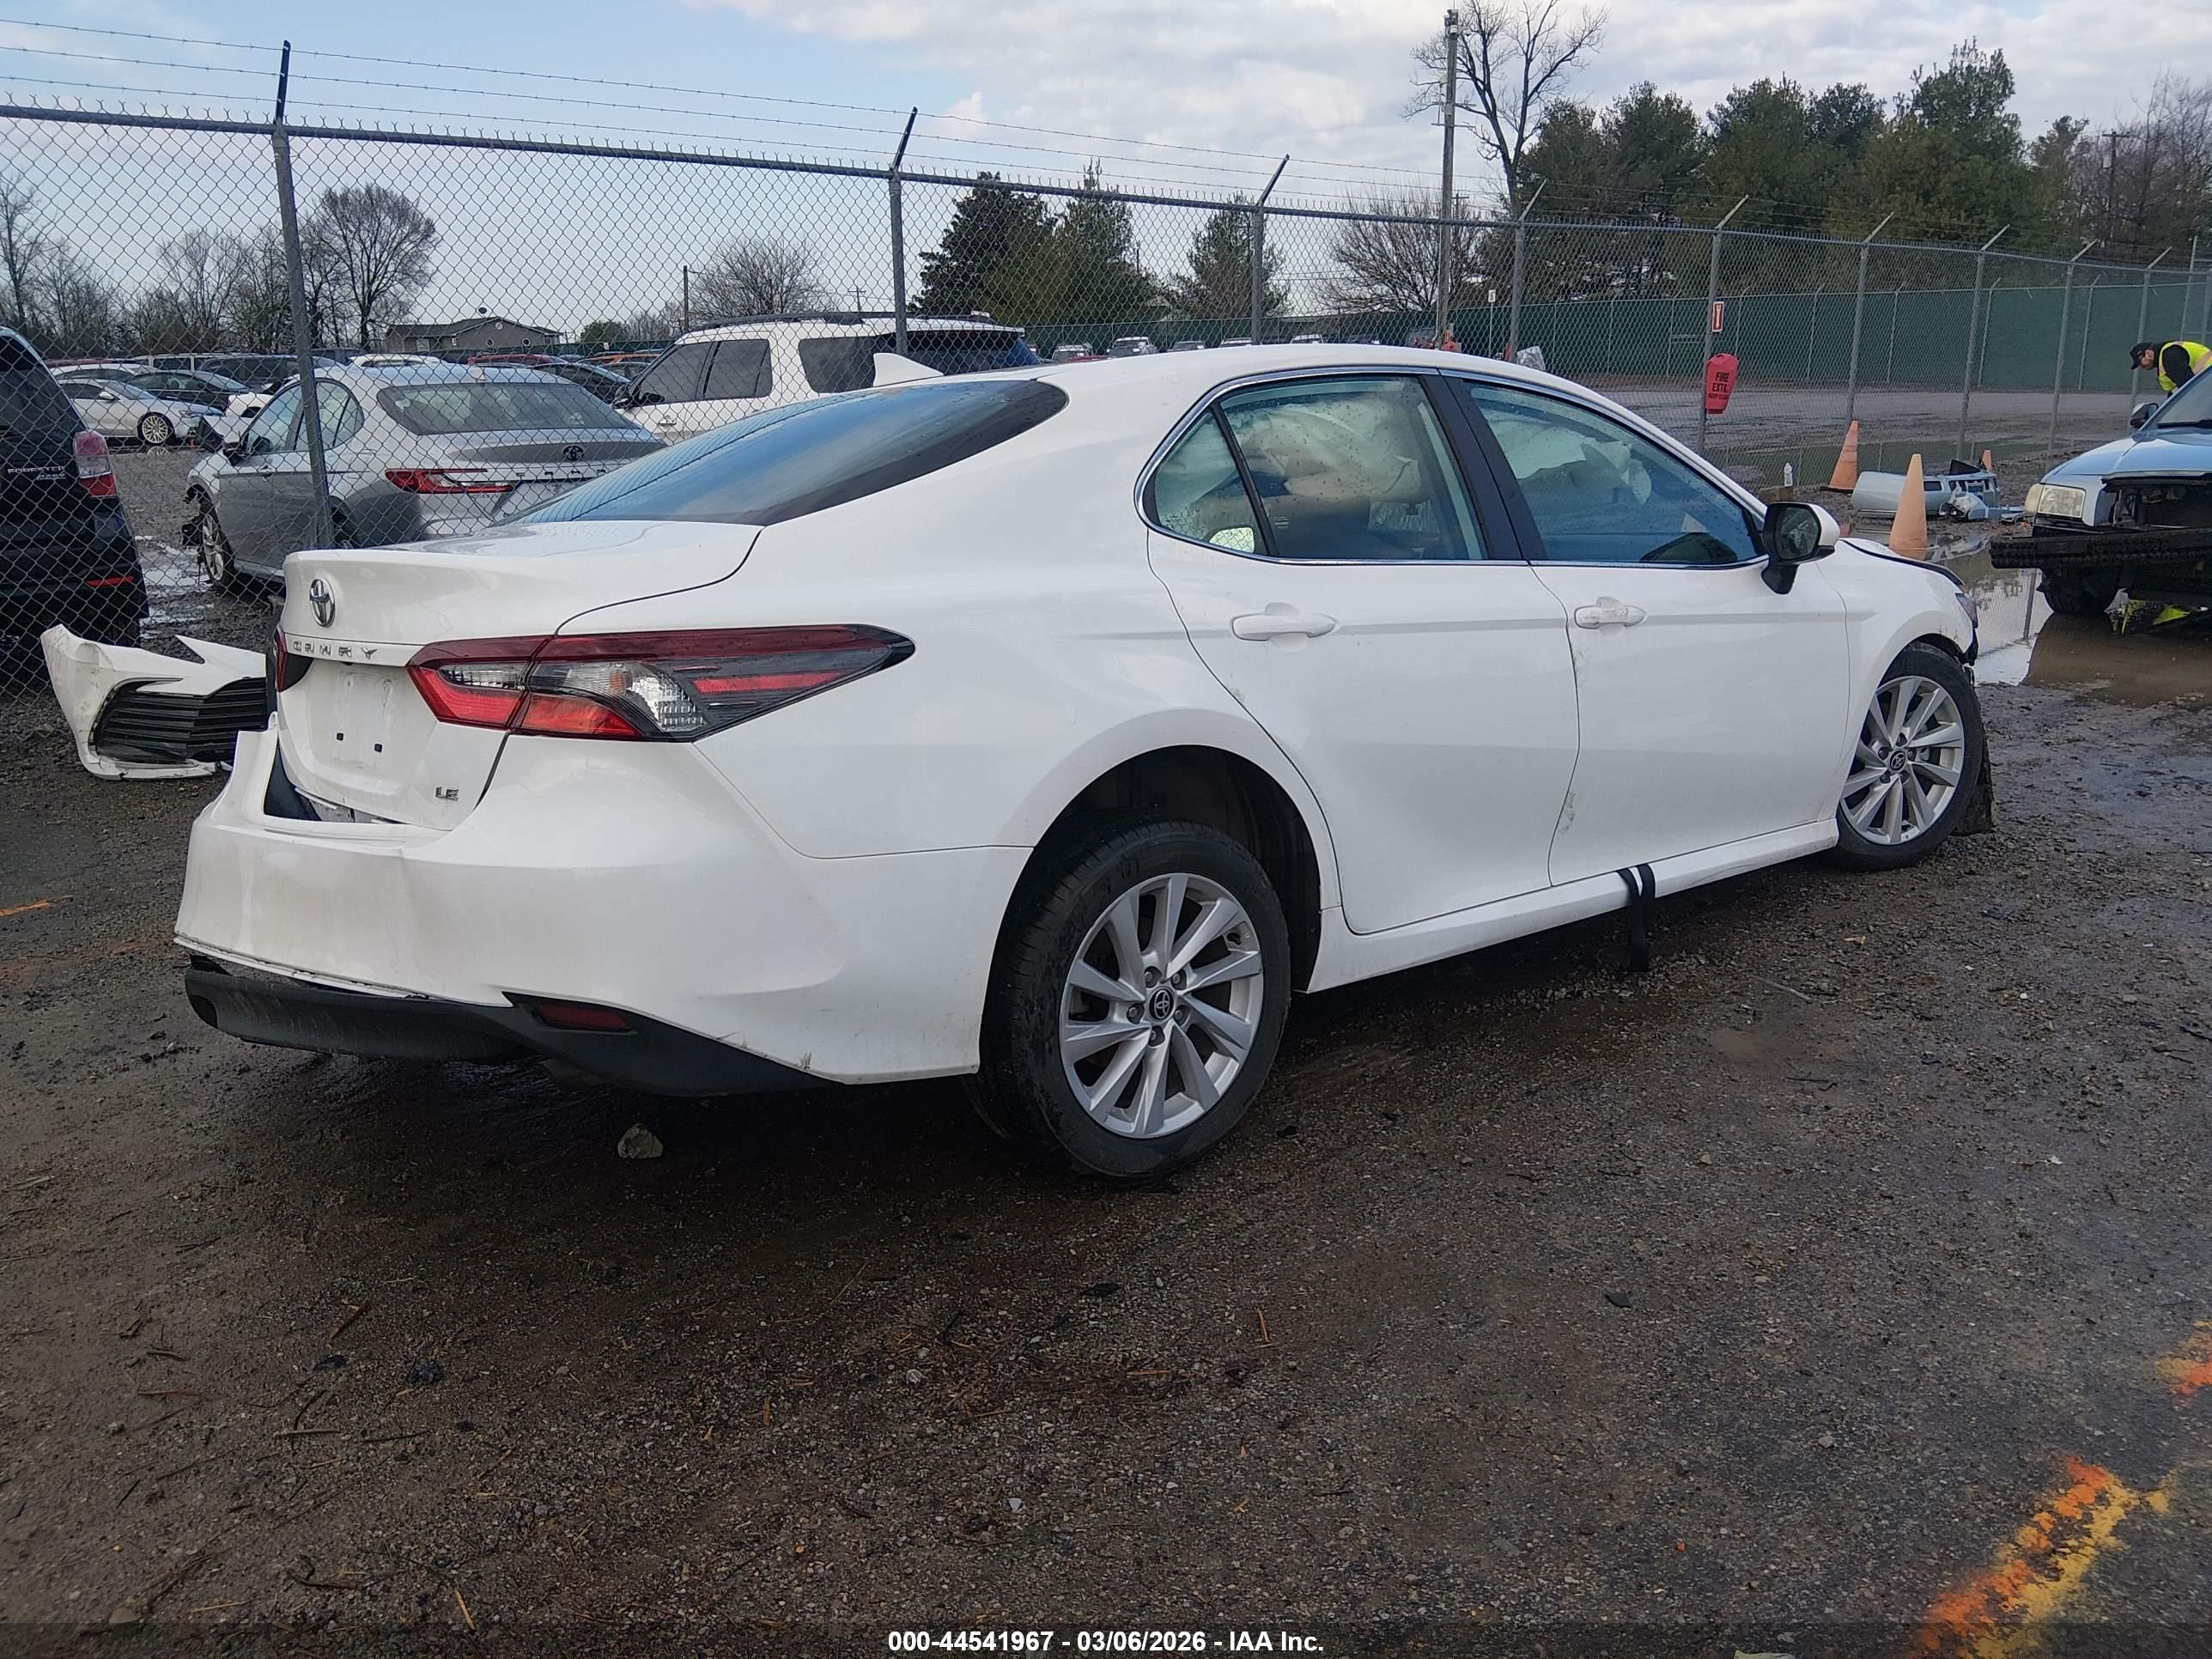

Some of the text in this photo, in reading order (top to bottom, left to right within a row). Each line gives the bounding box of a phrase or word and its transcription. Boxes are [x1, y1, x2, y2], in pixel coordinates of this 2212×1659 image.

[1716, 372, 1729, 382] FIRE
[293, 641, 378, 659] CAMRY
[435, 786, 459, 802] LE
